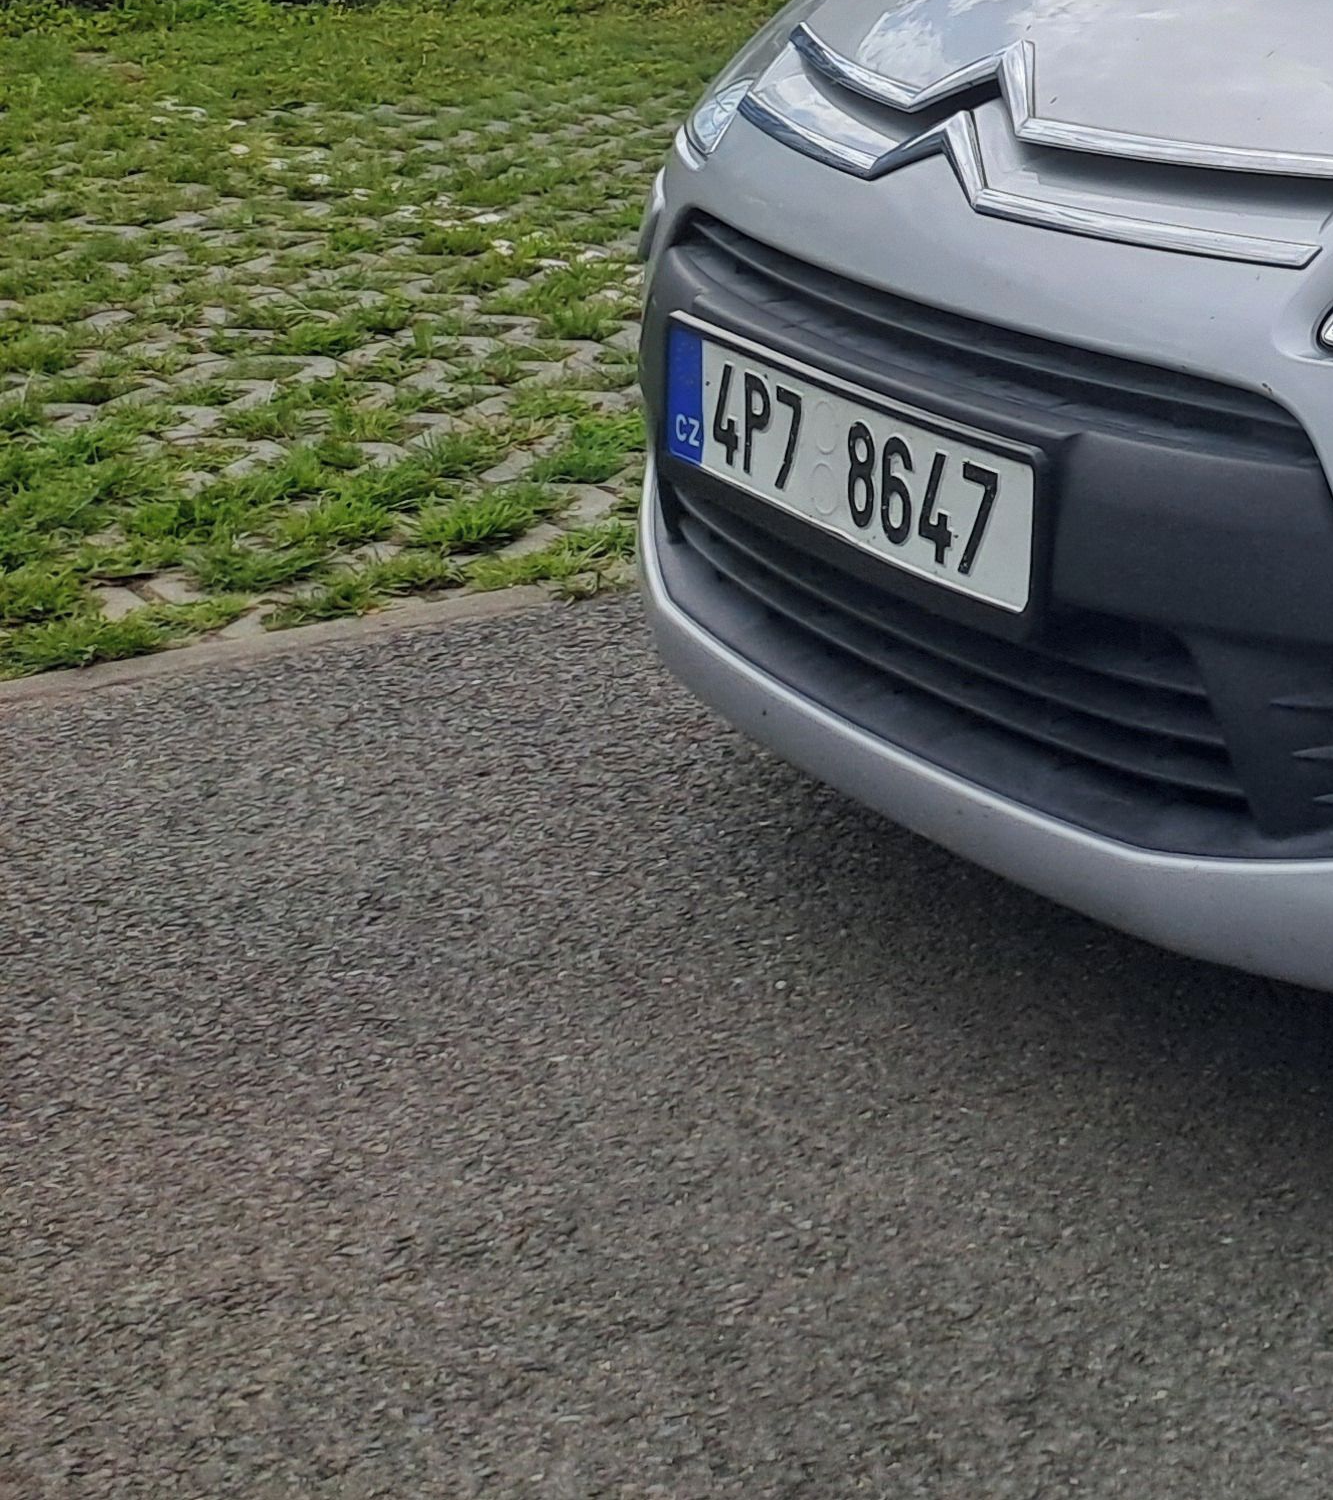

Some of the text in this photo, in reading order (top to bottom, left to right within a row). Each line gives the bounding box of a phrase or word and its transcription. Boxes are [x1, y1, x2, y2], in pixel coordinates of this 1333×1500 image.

[675, 413, 700, 448] CZ
[712, 362, 1000, 576] 4P7 8647
